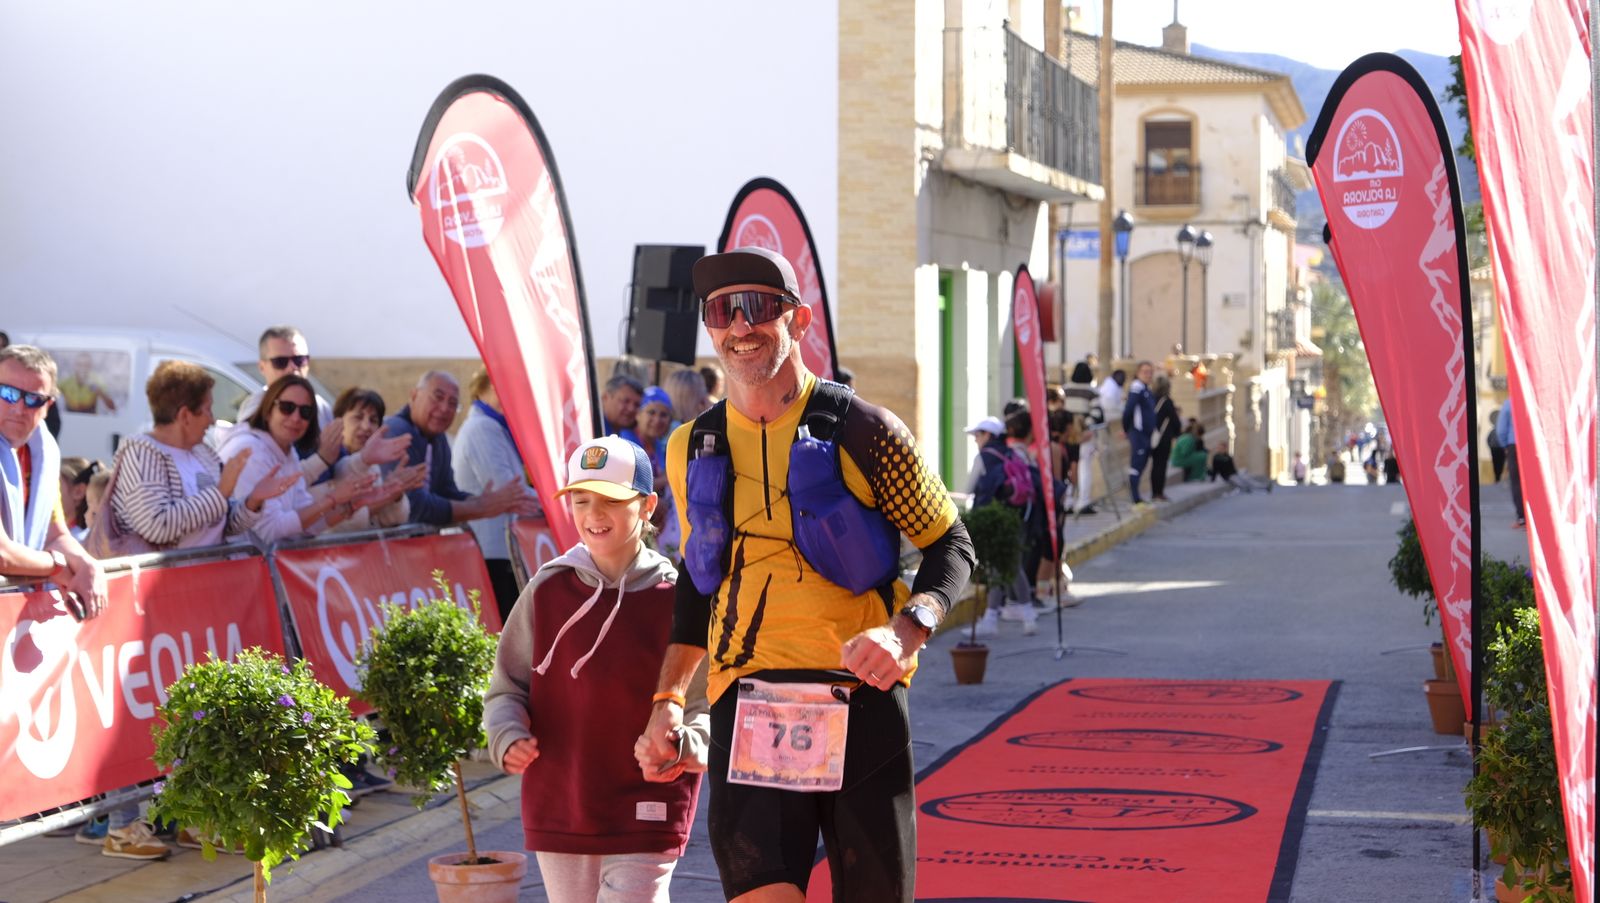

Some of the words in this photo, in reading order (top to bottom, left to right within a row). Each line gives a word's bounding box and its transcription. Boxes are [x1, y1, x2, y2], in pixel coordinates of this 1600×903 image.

[768, 722, 812, 751] 76
[943, 849, 1107, 862] Cantoria
[1120, 856, 1166, 864] de
[916, 857, 1187, 873] Ayuntamiento
